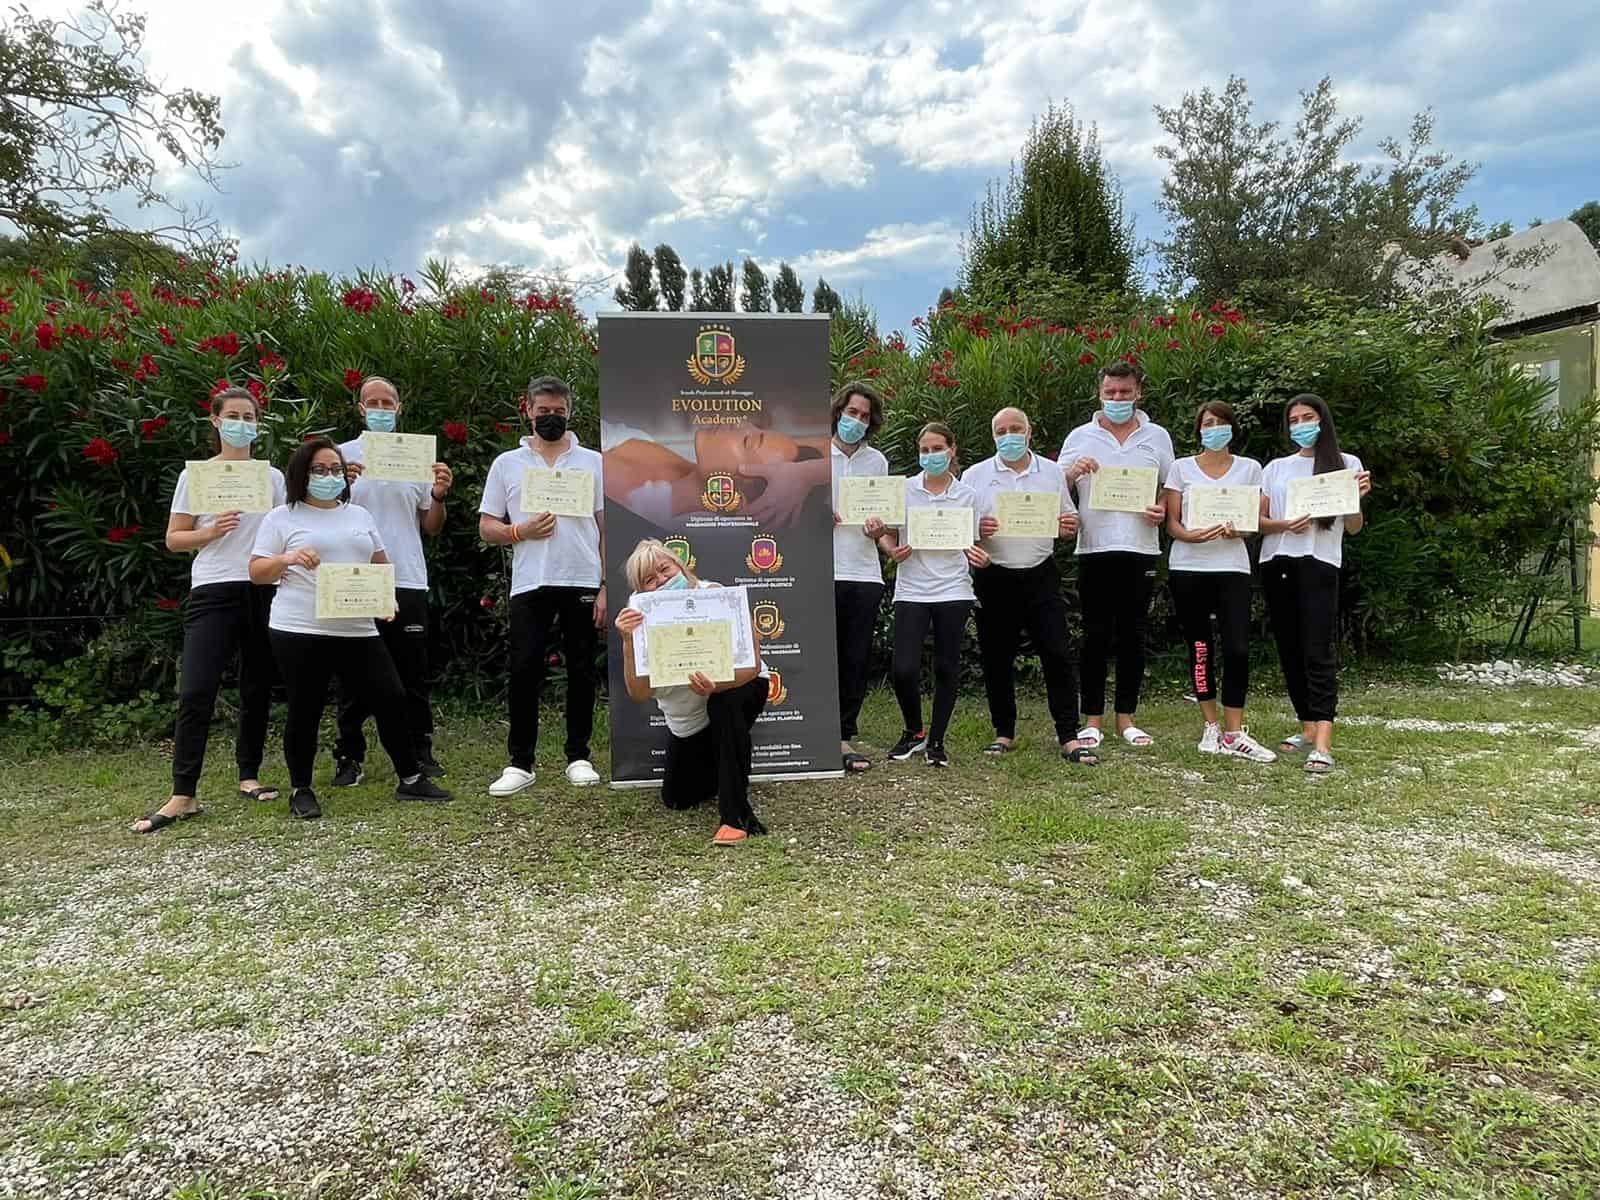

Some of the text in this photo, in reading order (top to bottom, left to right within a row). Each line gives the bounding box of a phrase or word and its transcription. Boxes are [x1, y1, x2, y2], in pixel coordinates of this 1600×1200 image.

[672, 399, 762, 411] EVOLUTION
[1195, 640, 1209, 693] NEVER STOP
